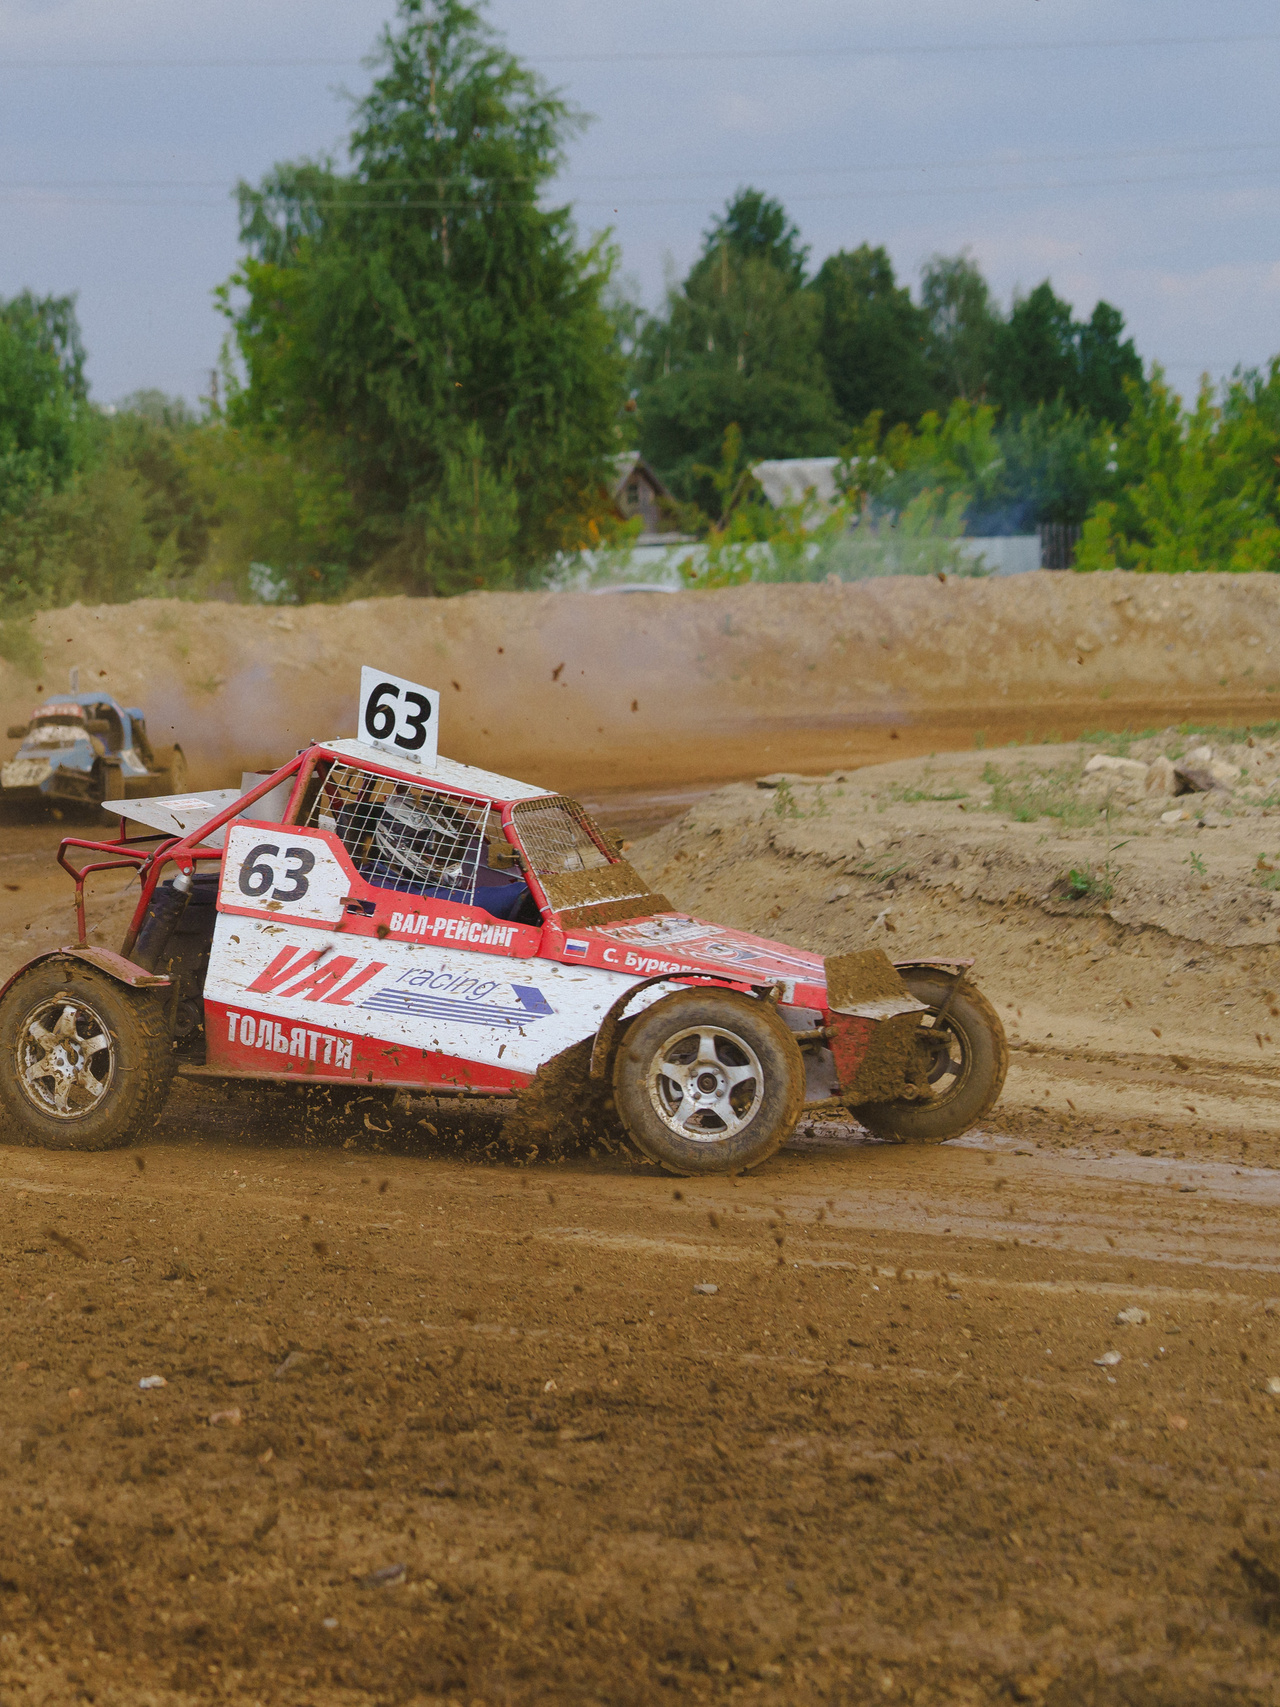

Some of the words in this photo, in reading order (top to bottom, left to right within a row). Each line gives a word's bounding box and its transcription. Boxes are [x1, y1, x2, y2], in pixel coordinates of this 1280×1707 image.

[365, 682, 432, 750] 63
[239, 843, 316, 902] 63
[389, 911, 519, 948] ВАЛ-РЕЙСИНГ
[246, 945, 388, 1006] VAL
[396, 966, 502, 1001] racing
[603, 948, 619, 964] С.
[624, 951, 707, 976] Бурка
[227, 1012, 353, 1070] ТОЛЬЯТТИ
